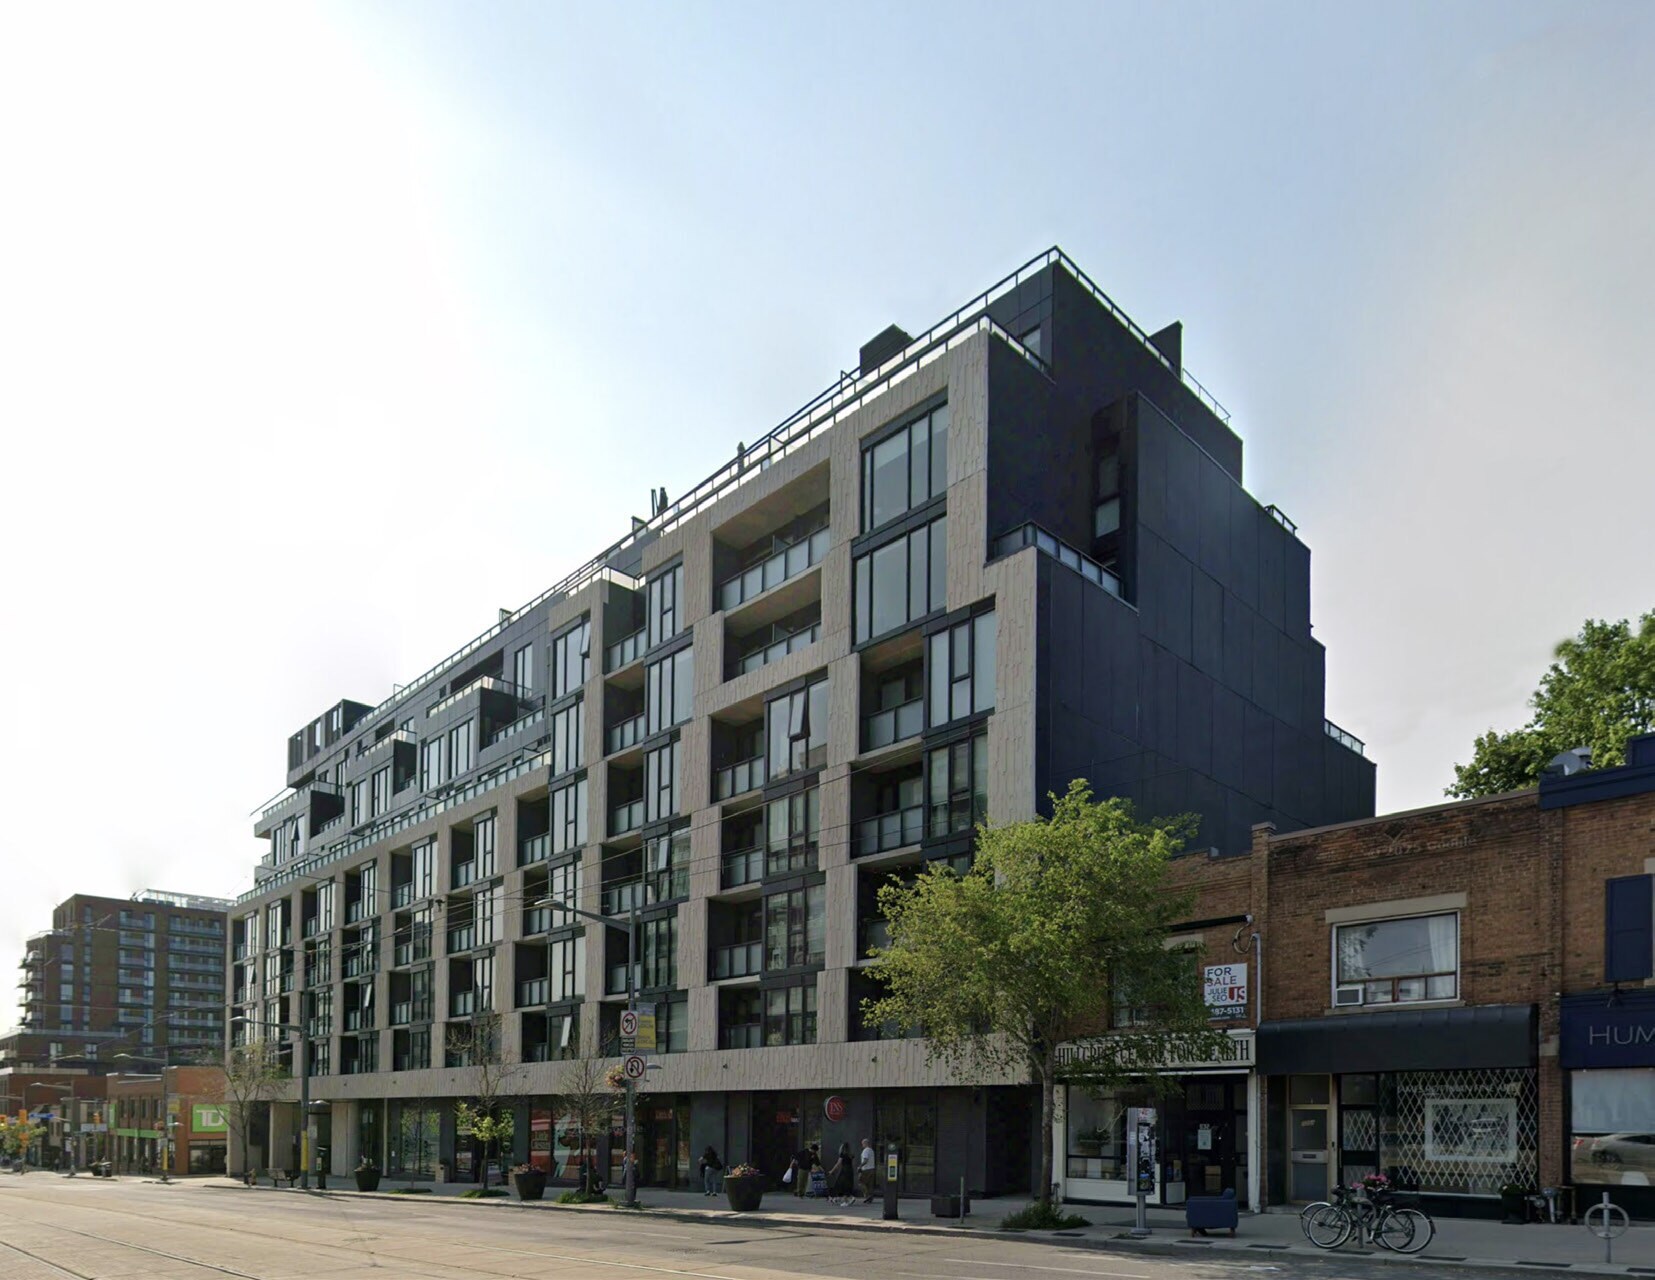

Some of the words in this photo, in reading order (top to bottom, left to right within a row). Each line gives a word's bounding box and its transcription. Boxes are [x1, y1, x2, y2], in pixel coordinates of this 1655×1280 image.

[1207, 966, 1232, 977] FOR
[1206, 975, 1237, 987] SALE
[1207, 987, 1227, 996] JULIE
[1212, 994, 1228, 1003] SEO
[196, 1109, 225, 1128] TD
